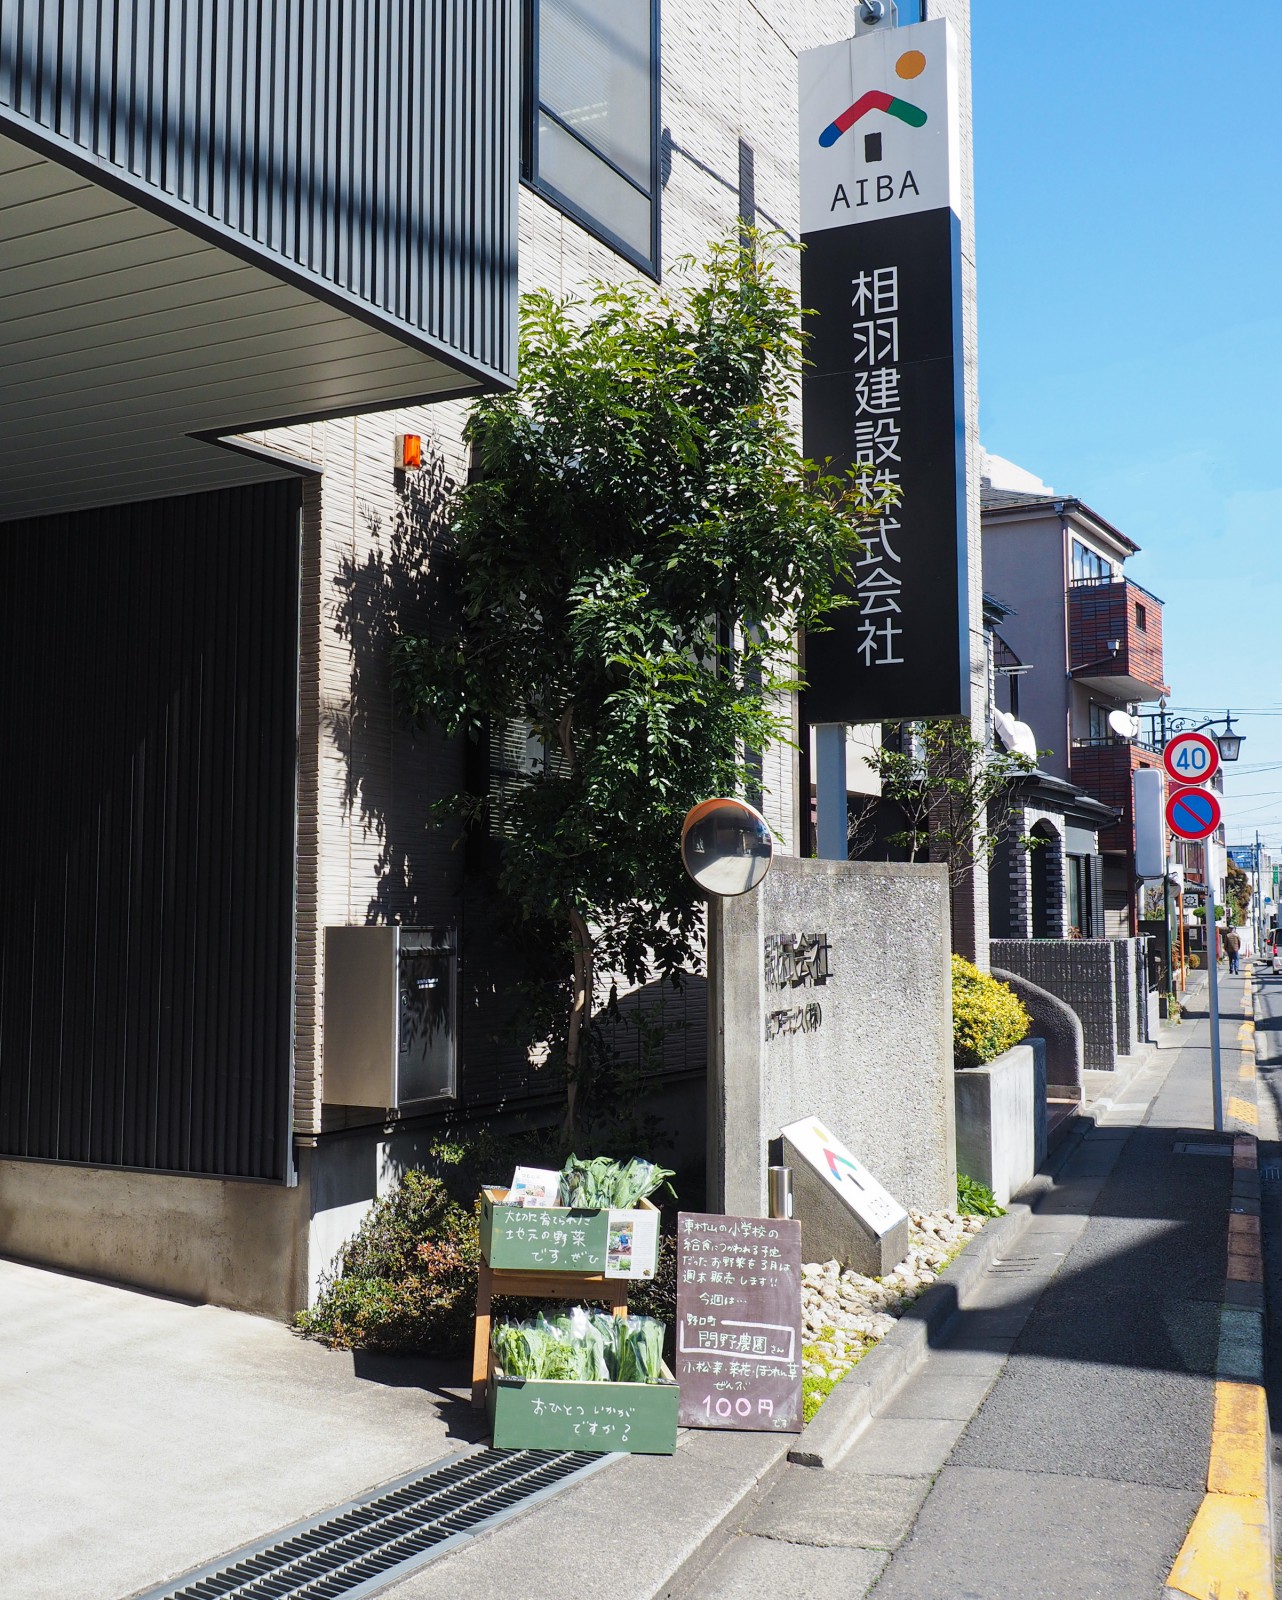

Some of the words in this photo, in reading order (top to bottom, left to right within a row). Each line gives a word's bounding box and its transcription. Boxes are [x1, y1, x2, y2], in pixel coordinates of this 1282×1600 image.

[830, 170, 920, 212] AIBA
[851, 265, 905, 667] 相羽建設株式会社
[1176, 747, 1207, 770] 40
[504, 1209, 592, 1226] 大切に育てられた
[504, 1226, 587, 1248] 地元の野菜
[683, 1218, 779, 1239] 東村山の小学校の
[686, 1312, 717, 1327] 野口町
[713, 1380, 752, 1391] ぜんぶ
[530, 1397, 586, 1417] おひとつ
[593, 1405, 636, 1418] いかが
[702, 1394, 774, 1418] 100円
[772, 1417, 788, 1429] です
